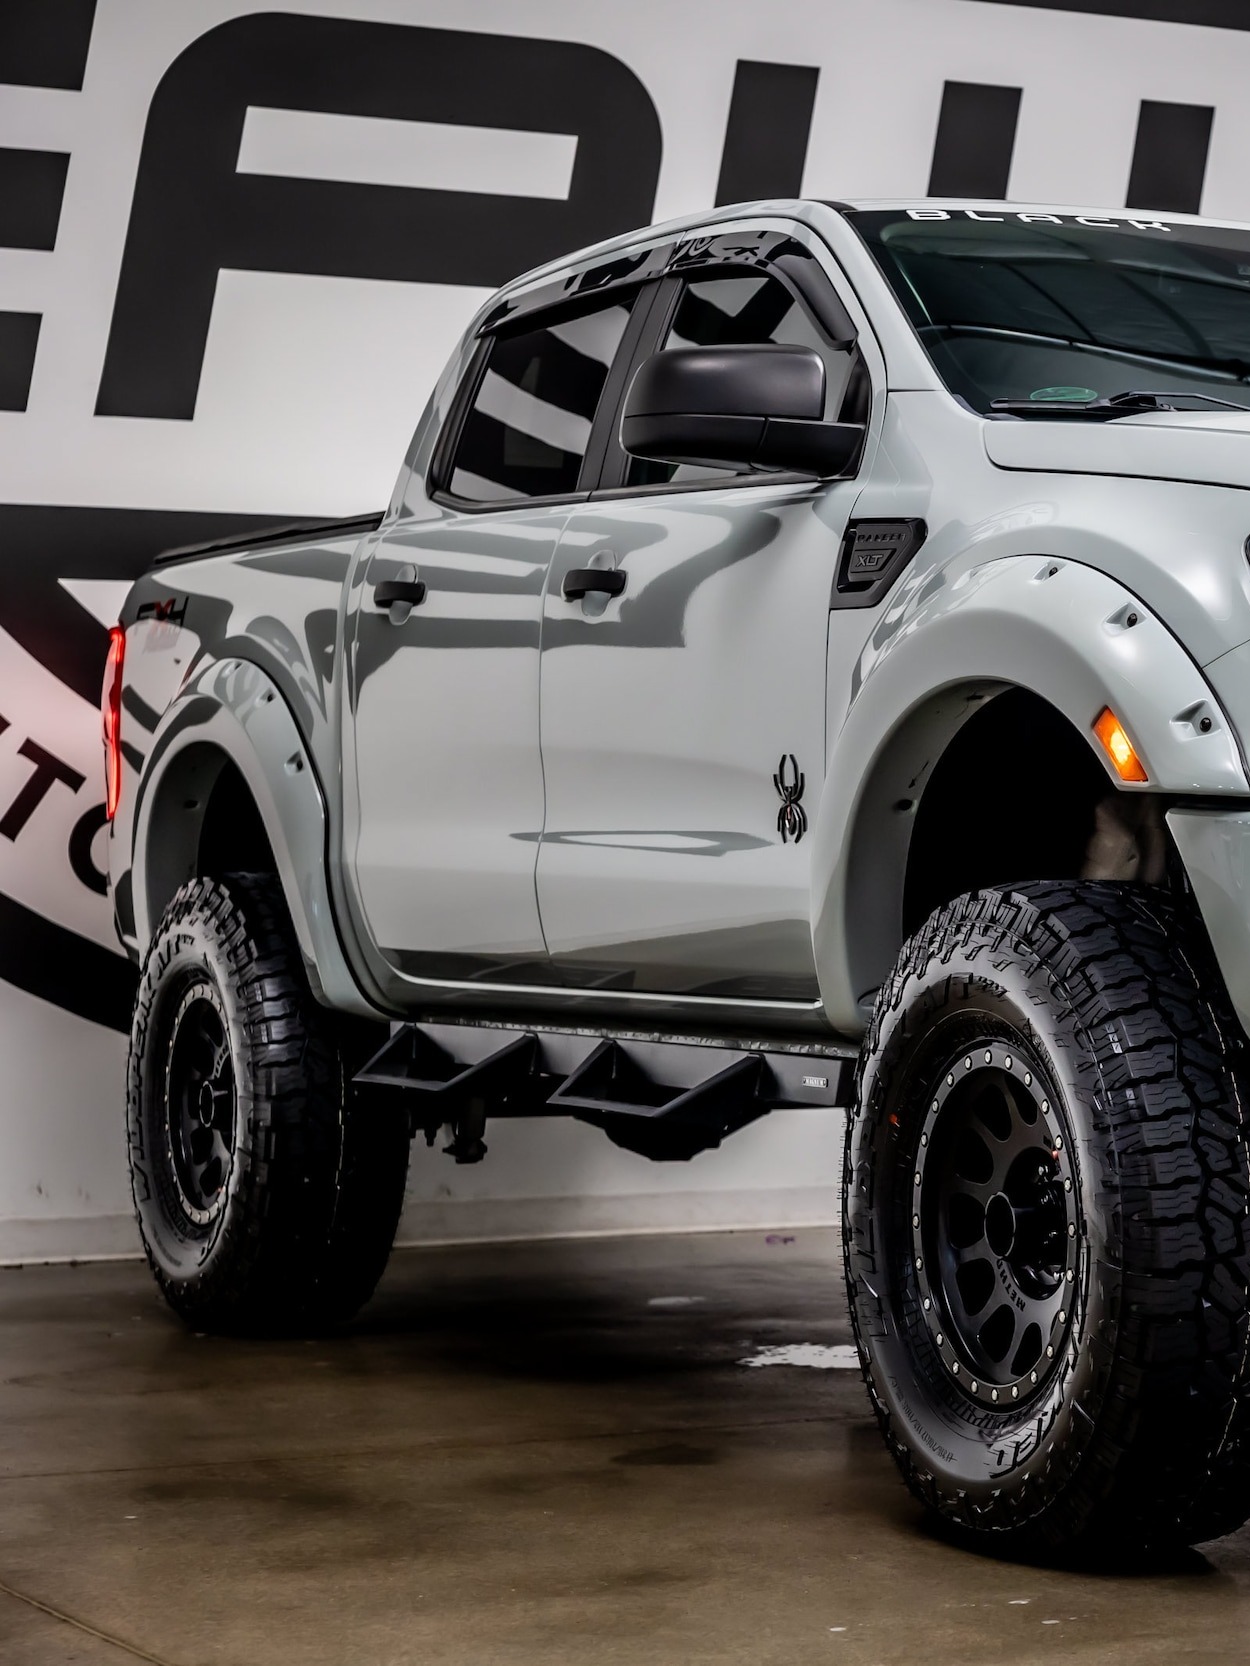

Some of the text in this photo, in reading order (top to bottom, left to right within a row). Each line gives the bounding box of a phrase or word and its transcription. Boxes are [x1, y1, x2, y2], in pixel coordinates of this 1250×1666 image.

[906, 208, 1171, 232] BLACK
[857, 533, 906, 541] RANGER
[855, 554, 884, 567] XLT
